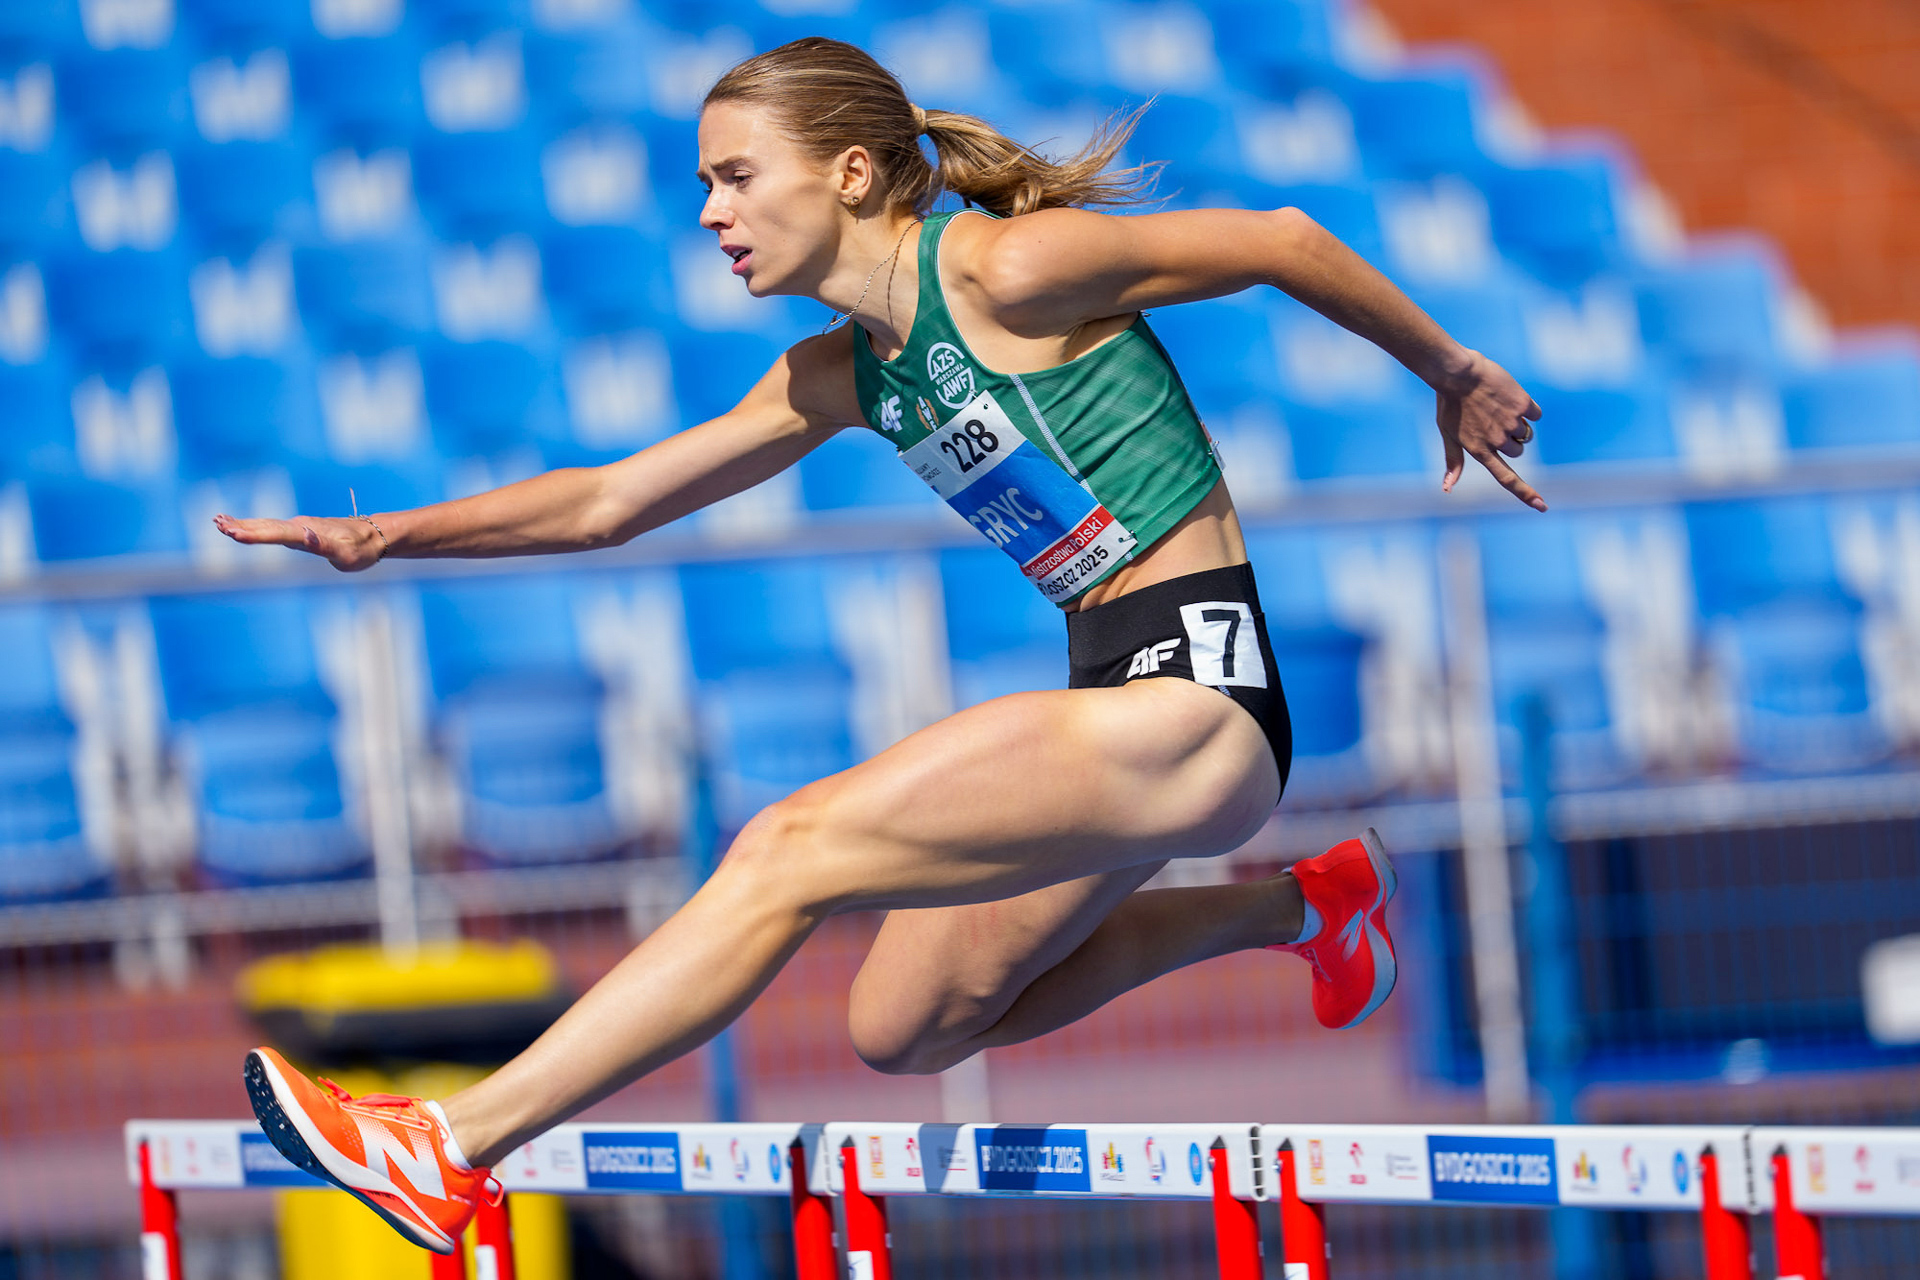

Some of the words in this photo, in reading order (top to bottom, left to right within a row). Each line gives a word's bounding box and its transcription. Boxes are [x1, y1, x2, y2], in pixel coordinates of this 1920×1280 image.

[931, 349, 956, 376] AZS
[935, 362, 965, 386] WARSZAWA
[942, 374, 968, 401] AWF
[881, 394, 903, 433] 4F
[940, 419, 999, 473] 228
[968, 487, 1044, 548] GRYC
[1069, 516, 1104, 550] Polski
[1074, 544, 1109, 577] 2025
[1126, 637, 1182, 679] 4F
[1201, 609, 1242, 678] 7
